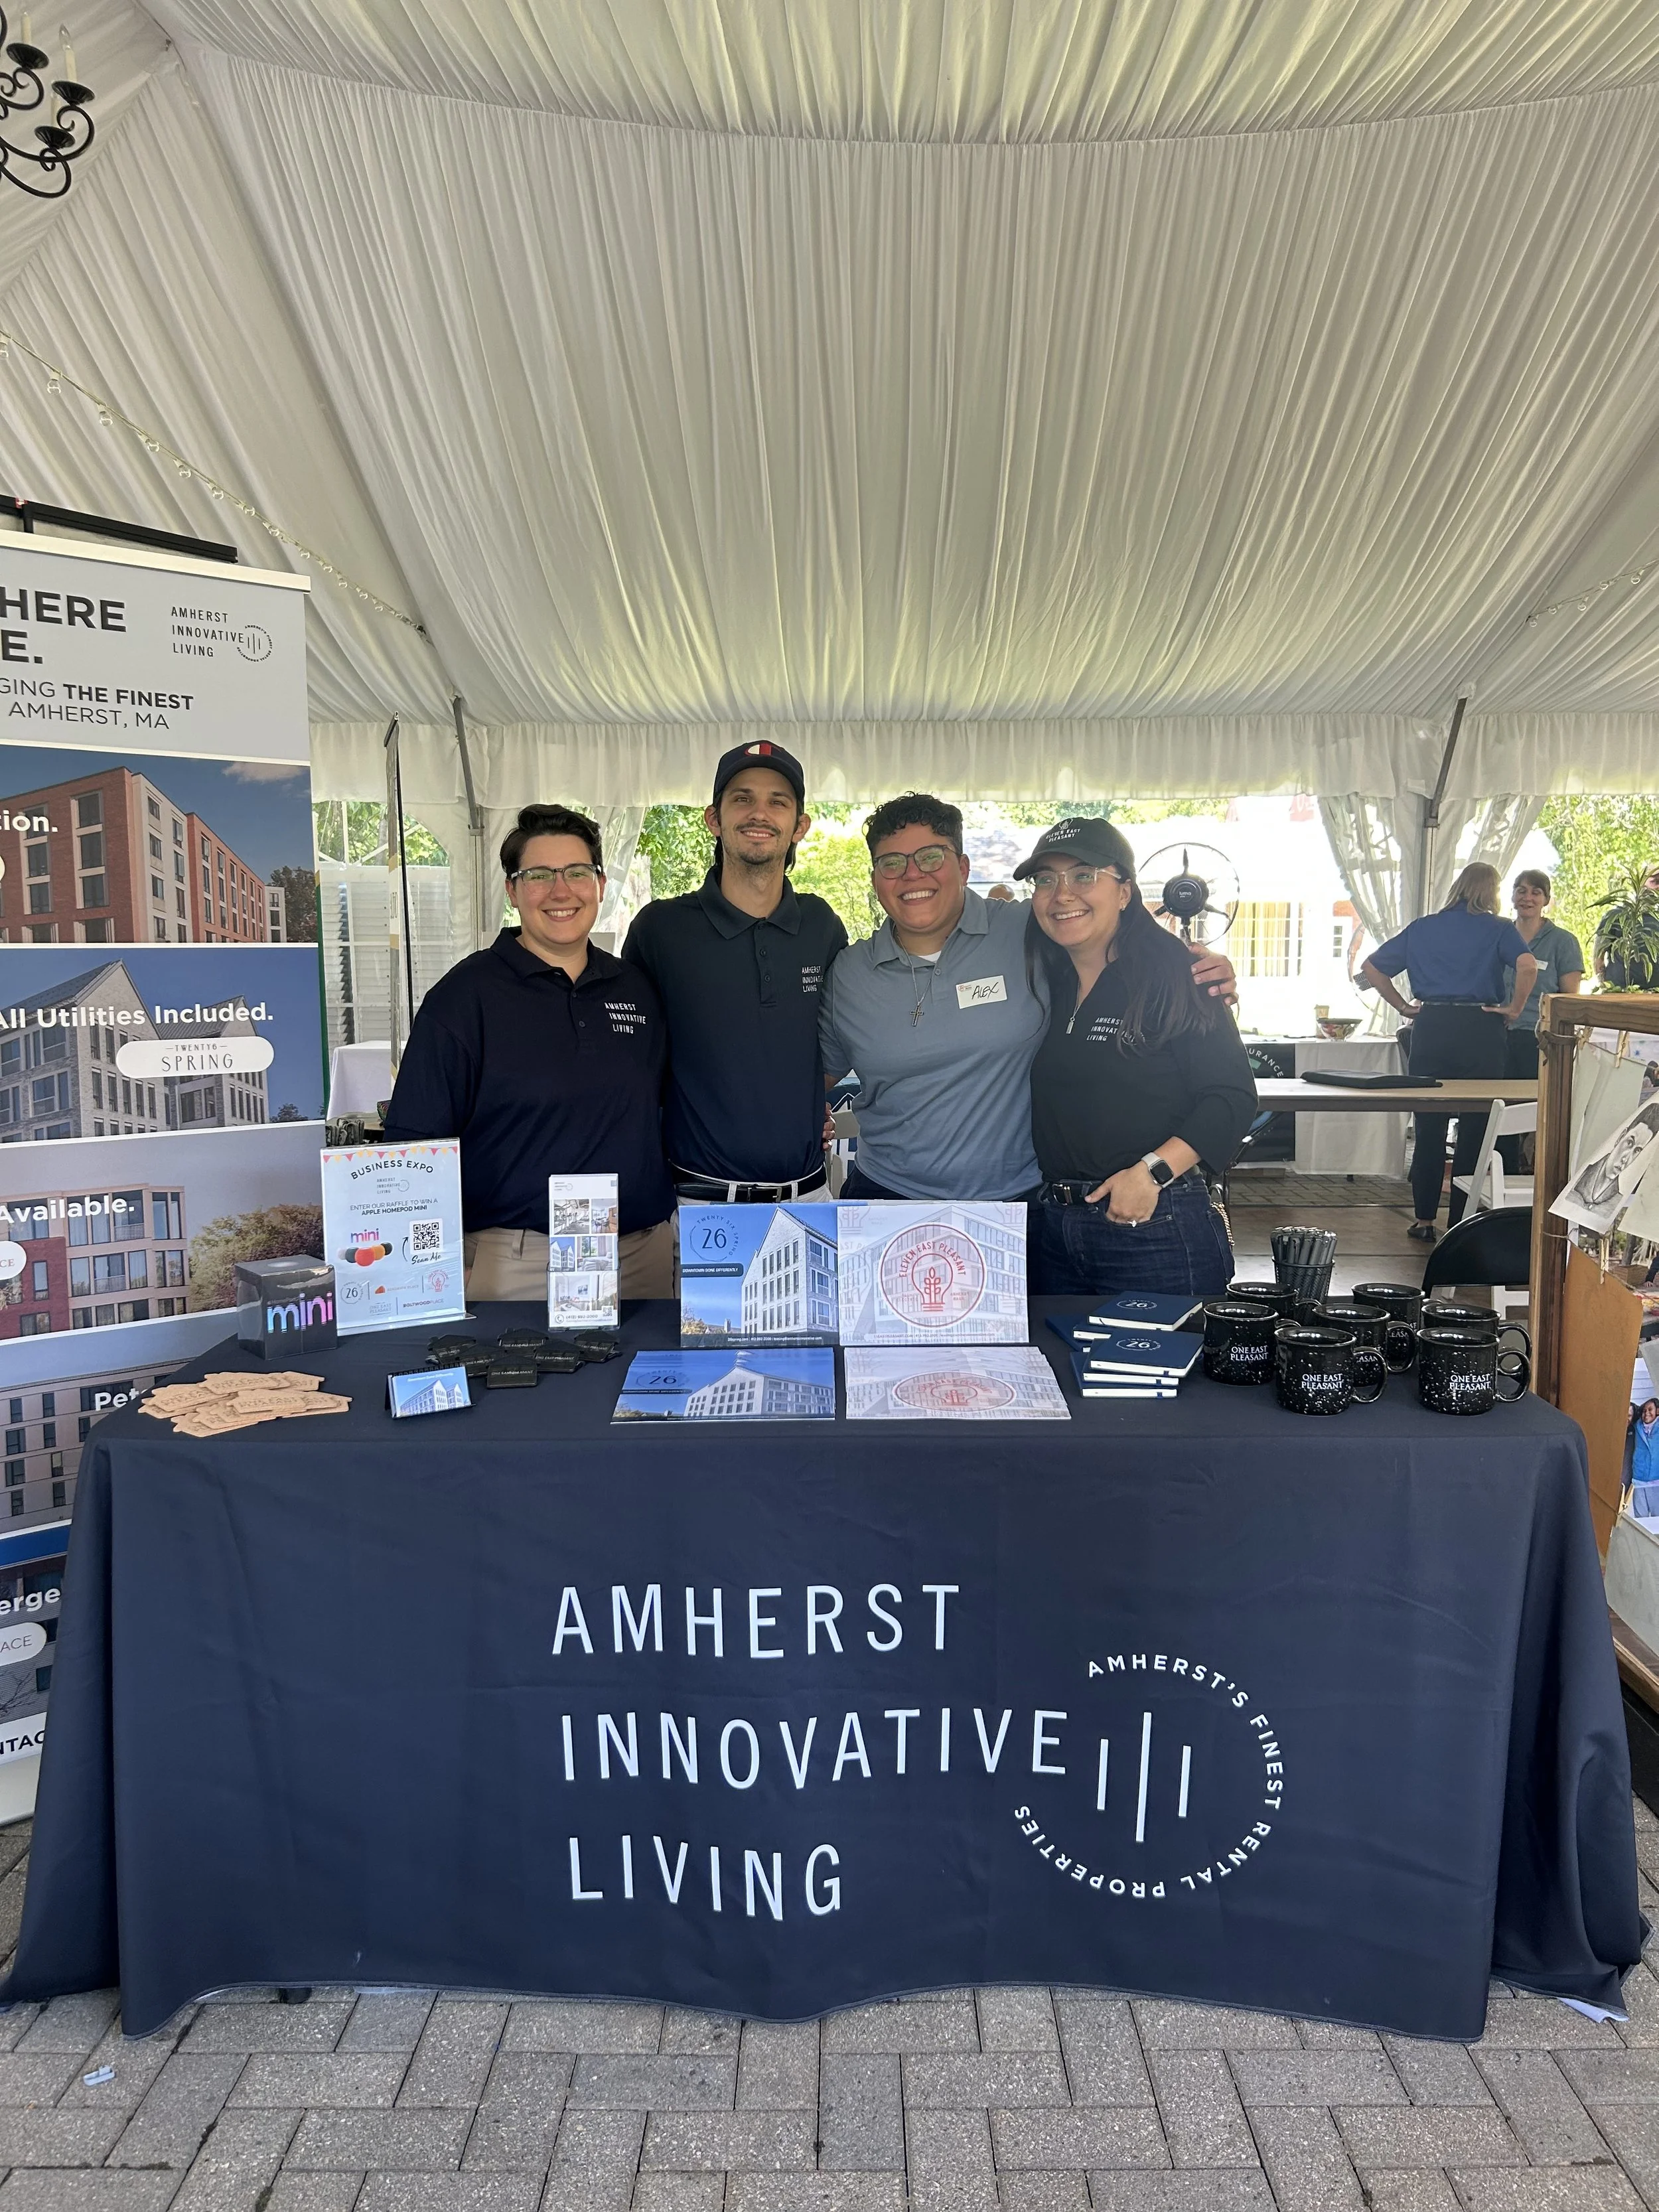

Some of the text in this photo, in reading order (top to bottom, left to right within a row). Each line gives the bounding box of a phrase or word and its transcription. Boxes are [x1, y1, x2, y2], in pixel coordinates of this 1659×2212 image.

[171, 606, 228, 623] AMHERST
[172, 625, 244, 643] INNOVATIVE
[1, 629, 42, 664] E.
[173, 642, 214, 657] LIVING
[0, 678, 194, 710] GING THE FINEST
[9, 701, 170, 729] AMHERST, MA
[802, 966, 821, 974] AMHERST
[972, 982, 999, 999] ALEX
[37, 1005, 146, 1029] Utilities
[155, 1001, 274, 1024] Included.
[604, 1002, 636, 1011] AMHERST
[609, 1012, 646, 1024] INNOVATIVE
[613, 1023, 634, 1034] LIVING
[175, 1043, 218, 1052] TWENTY6
[161, 1053, 234, 1072] SPRING
[350, 1159, 433, 1179] BUSINESS EXPO
[0, 1195, 135, 1224] Available.
[350, 1228, 380, 1244] mini
[697, 1215, 739, 1256] TWENTY SIX SPRING
[701, 1228, 727, 1249] 26
[411, 1255, 429, 1265] Scan
[899, 1241, 966, 1278] ELEVEN EAST PLEASANT
[345, 1287, 358, 1299] 26
[267, 1291, 333, 1334] mini
[1230, 1353, 1269, 1361] PLEASANT
[648, 1375, 677, 1384] 26
[1301, 1380, 1344, 1390] PLEASANT
[1302, 1373, 1321, 1382] ONE
[1449, 1382, 1490, 1391] PLEASANT
[1450, 1374, 1470, 1383] ONE
[95, 1387, 148, 1411] Pet
[552, 1584, 960, 1658] AMHERST
[0, 1634, 33, 1653] ACE
[561, 1708, 1068, 1790] INNOVATIVE
[1014, 1654, 1283, 1898] AMHERST'S FINEST RENTAL PROPERTIES
[569, 1835, 841, 1921] LIVING
